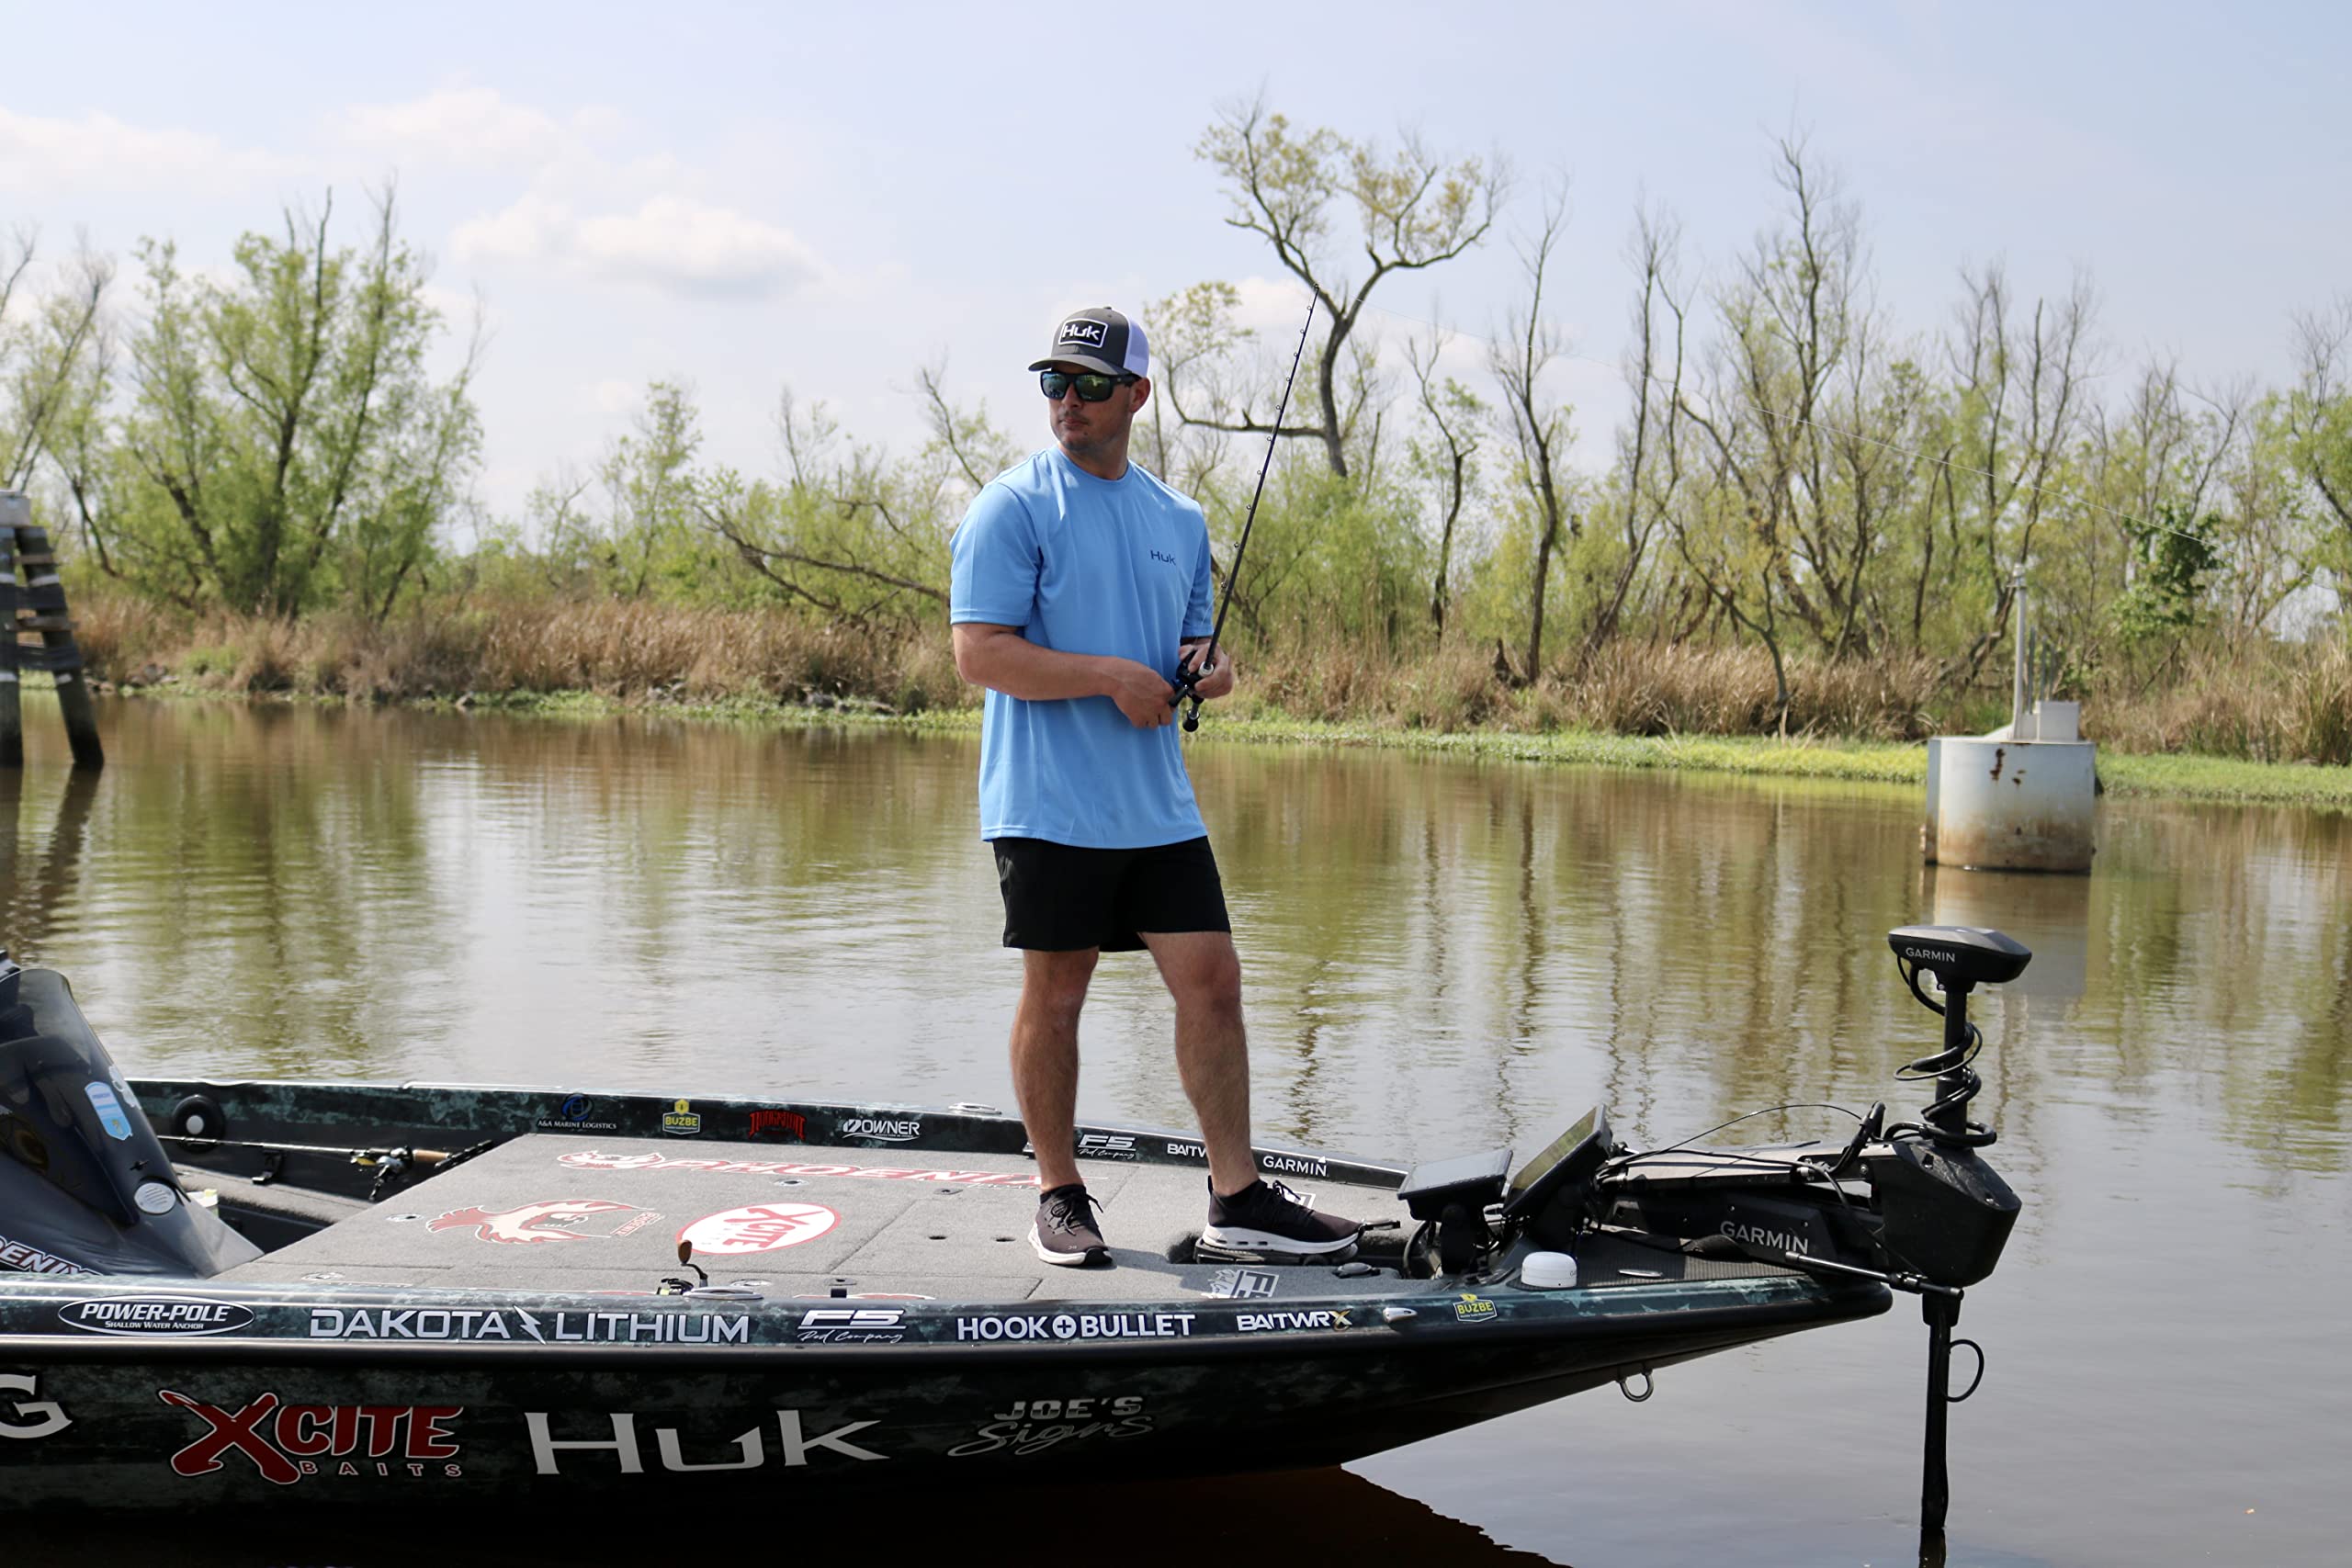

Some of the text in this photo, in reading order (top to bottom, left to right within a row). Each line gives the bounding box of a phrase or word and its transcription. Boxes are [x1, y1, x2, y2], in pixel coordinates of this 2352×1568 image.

[1905, 947, 1955, 963] GARMIN
[582, 1122, 617, 1130] LOGISTICS
[665, 1116, 698, 1126] BUZBE
[862, 1119, 920, 1135] OWNER
[1080, 1134, 1136, 1148] F5
[1167, 1144, 1207, 1157] BAIT
[1263, 1156, 1327, 1176] GARMIN
[1720, 1221, 1808, 1255] GARMIN
[80, 1303, 229, 1322] POWER-POLE
[1457, 1303, 1493, 1314] BUZBE
[311, 1310, 749, 1342] DAKOTA LITHIUM
[798, 1310, 904, 1326] F5
[1236, 1308, 1352, 1331] BAITWRX
[957, 1314, 1195, 1340] HOOK BULLET
[994, 1396, 1143, 1420] JOE'S
[298, 1461, 462, 1477] BAITS
